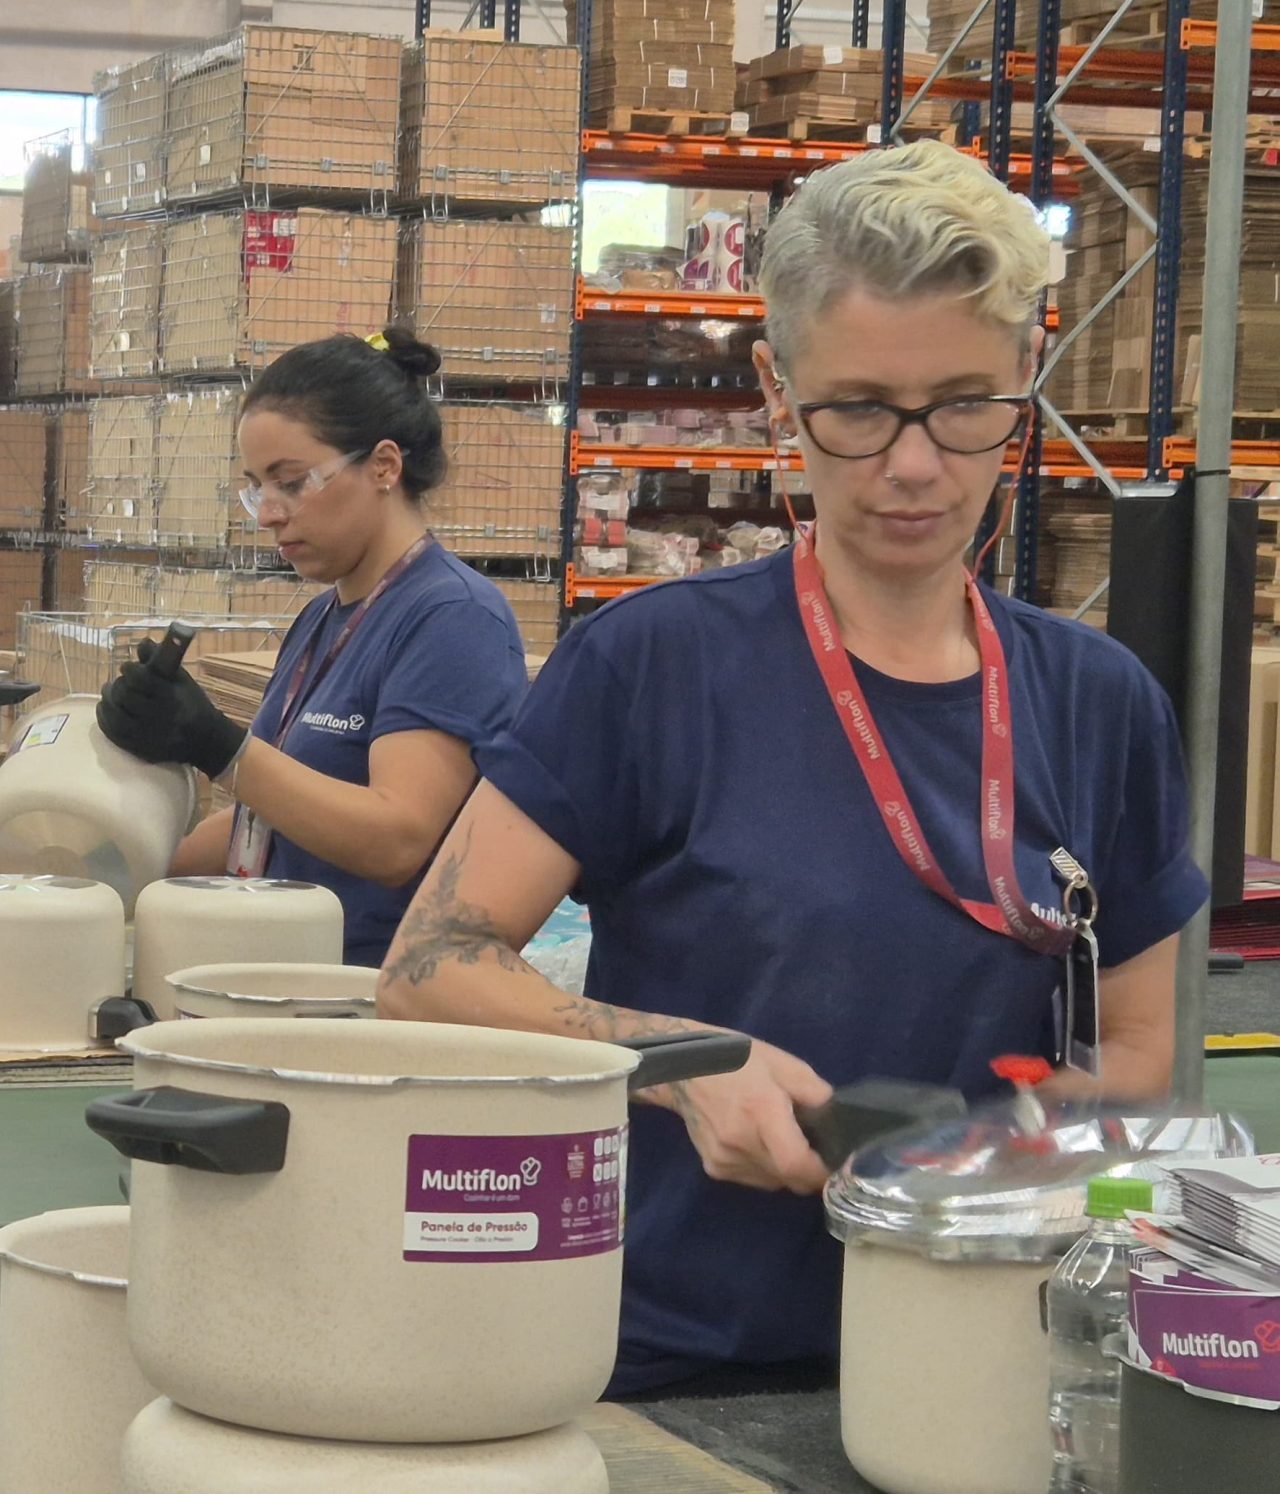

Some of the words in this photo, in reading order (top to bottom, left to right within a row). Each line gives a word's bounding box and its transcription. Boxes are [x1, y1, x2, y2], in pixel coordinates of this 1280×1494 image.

[811, 596, 836, 652] Multiflon
[989, 665, 999, 723] Multiflon
[300, 711, 349, 731] Multiflon
[848, 699, 881, 761] Multiflon
[988, 779, 1001, 832] Multiflon
[896, 806, 931, 871] Multiflon
[421, 1168, 520, 1192] Multiflon
[421, 1221, 464, 1233] Panela
[467, 1221, 482, 1233] de
[485, 1221, 528, 1233] Pressão
[1162, 1332, 1259, 1358] Multiflon
